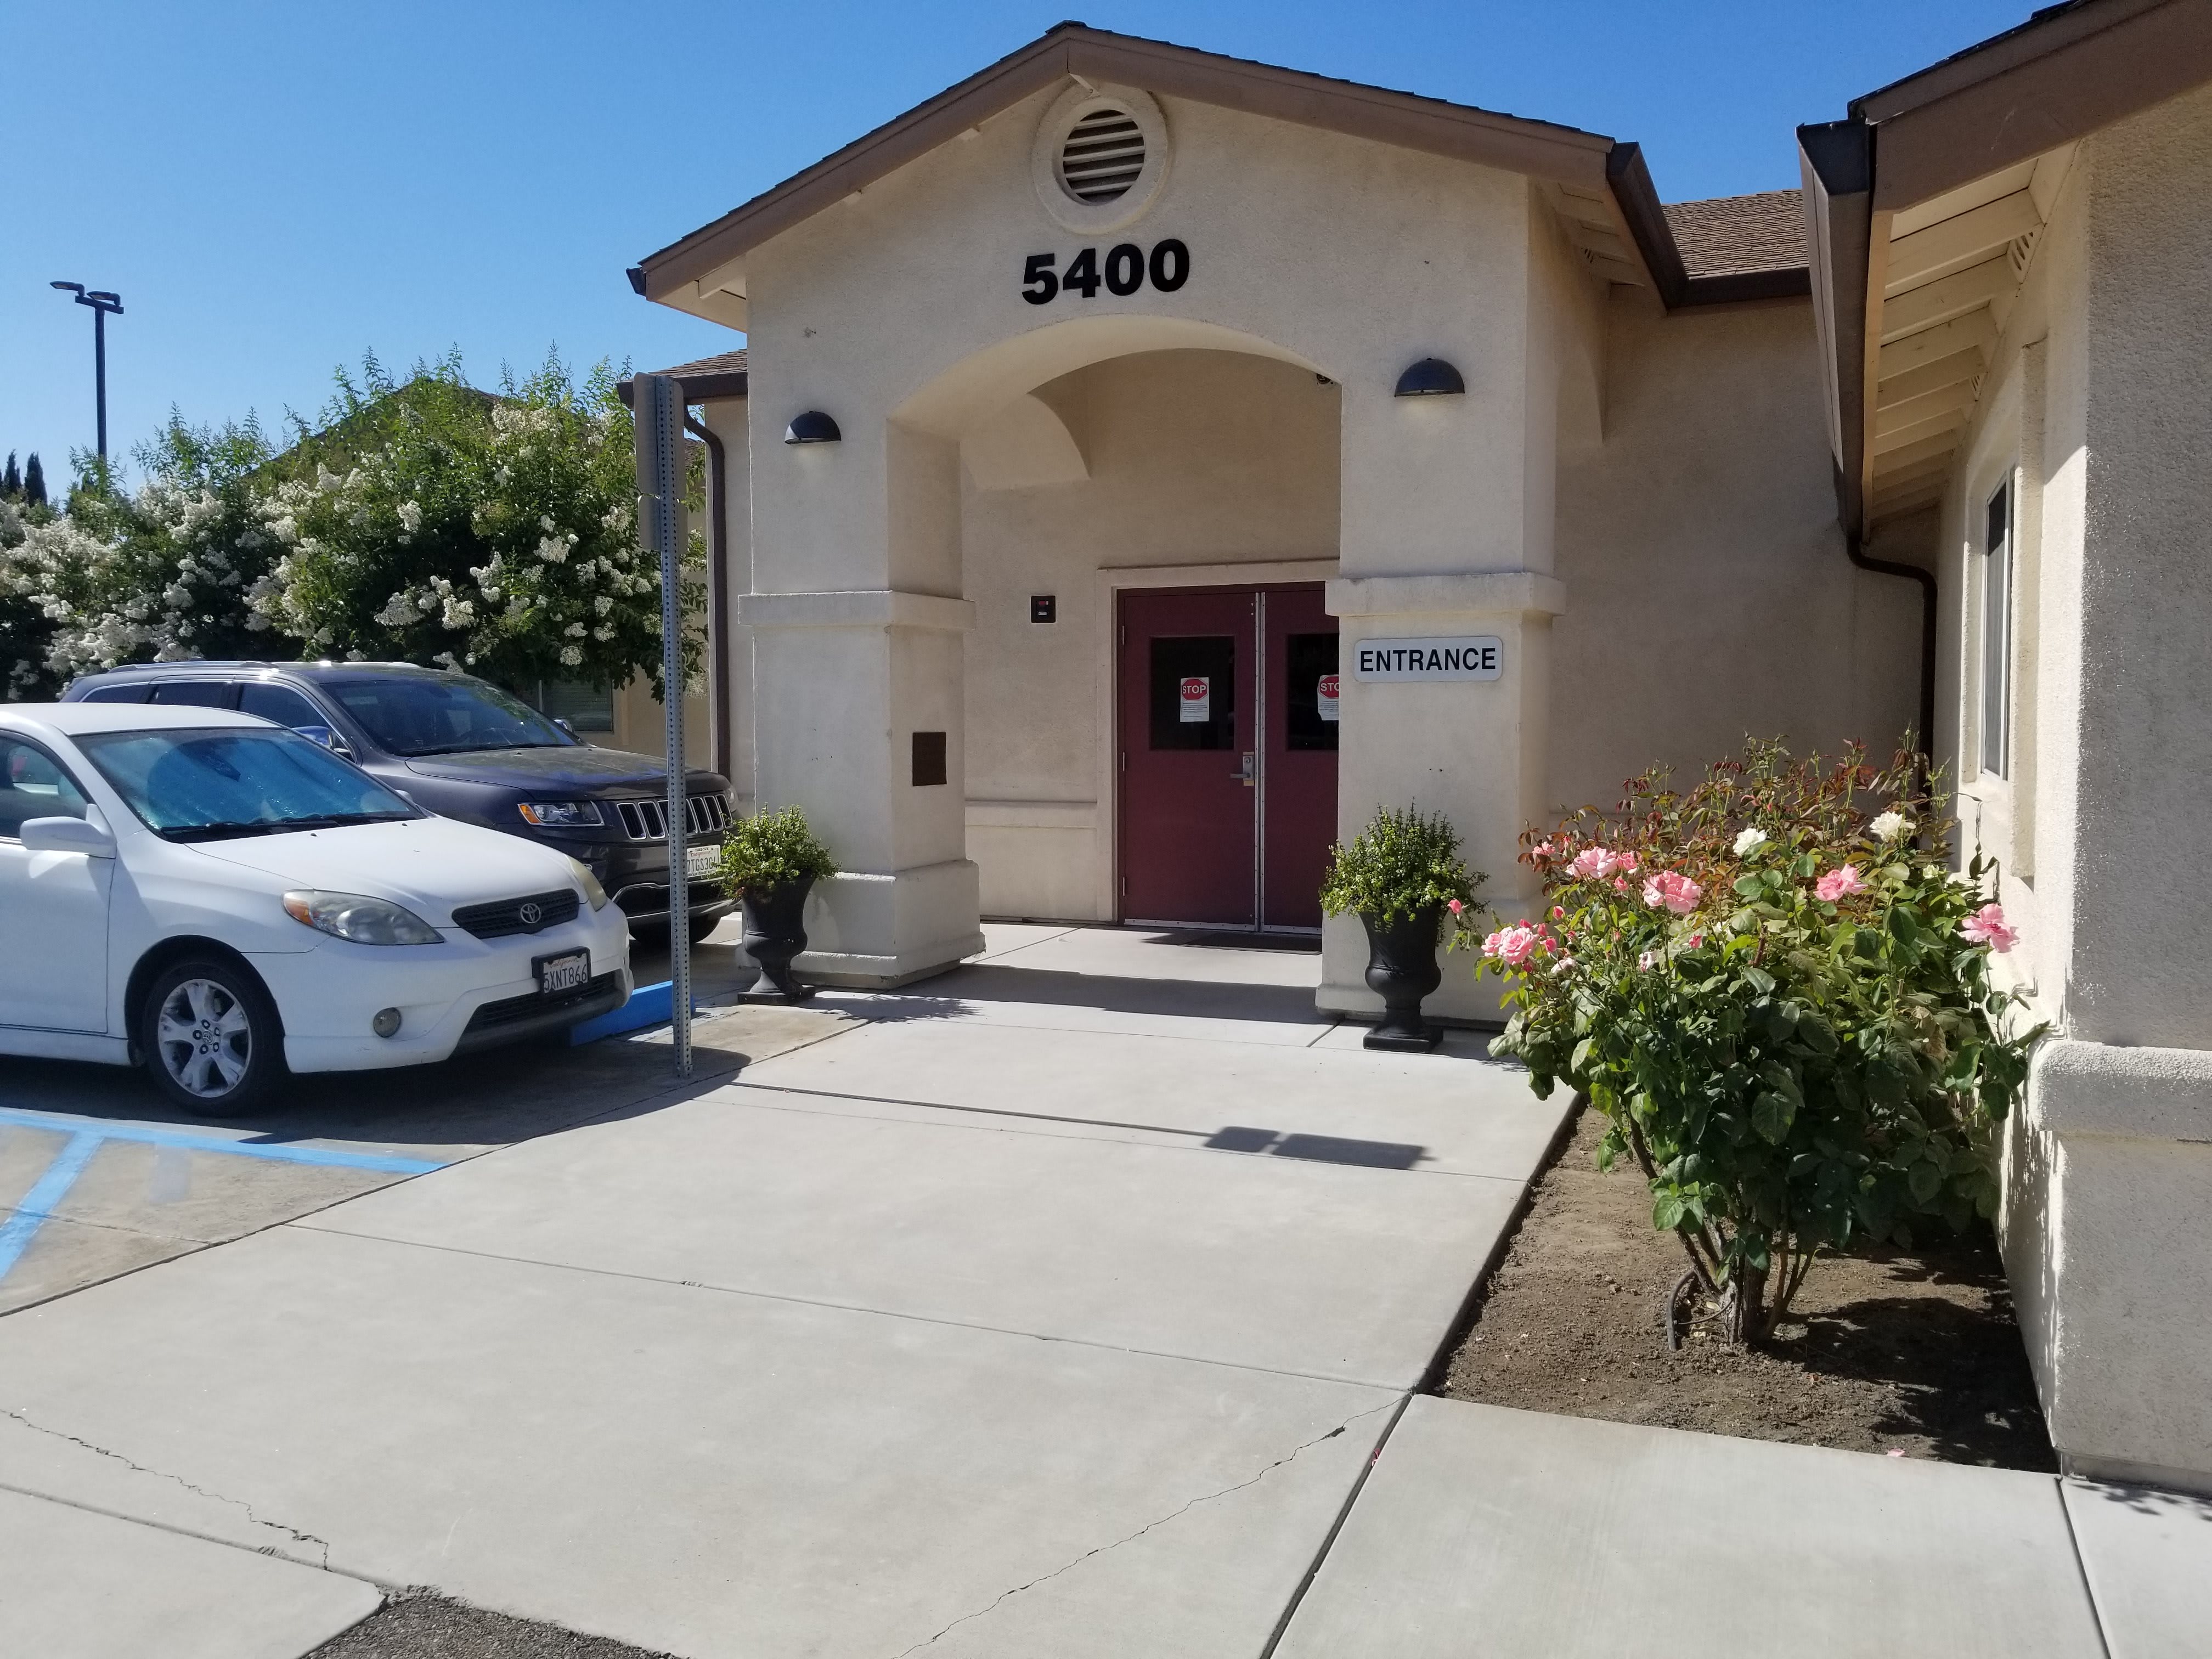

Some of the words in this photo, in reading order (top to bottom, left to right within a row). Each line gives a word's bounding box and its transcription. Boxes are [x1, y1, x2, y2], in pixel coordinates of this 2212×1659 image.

[1022, 239, 1189, 304] 5400
[1360, 647, 1496, 672] ENTRANCE
[1182, 685, 1206, 694] STOP
[1321, 682, 1339, 692] STO
[544, 964, 587, 991] 5XNT866
